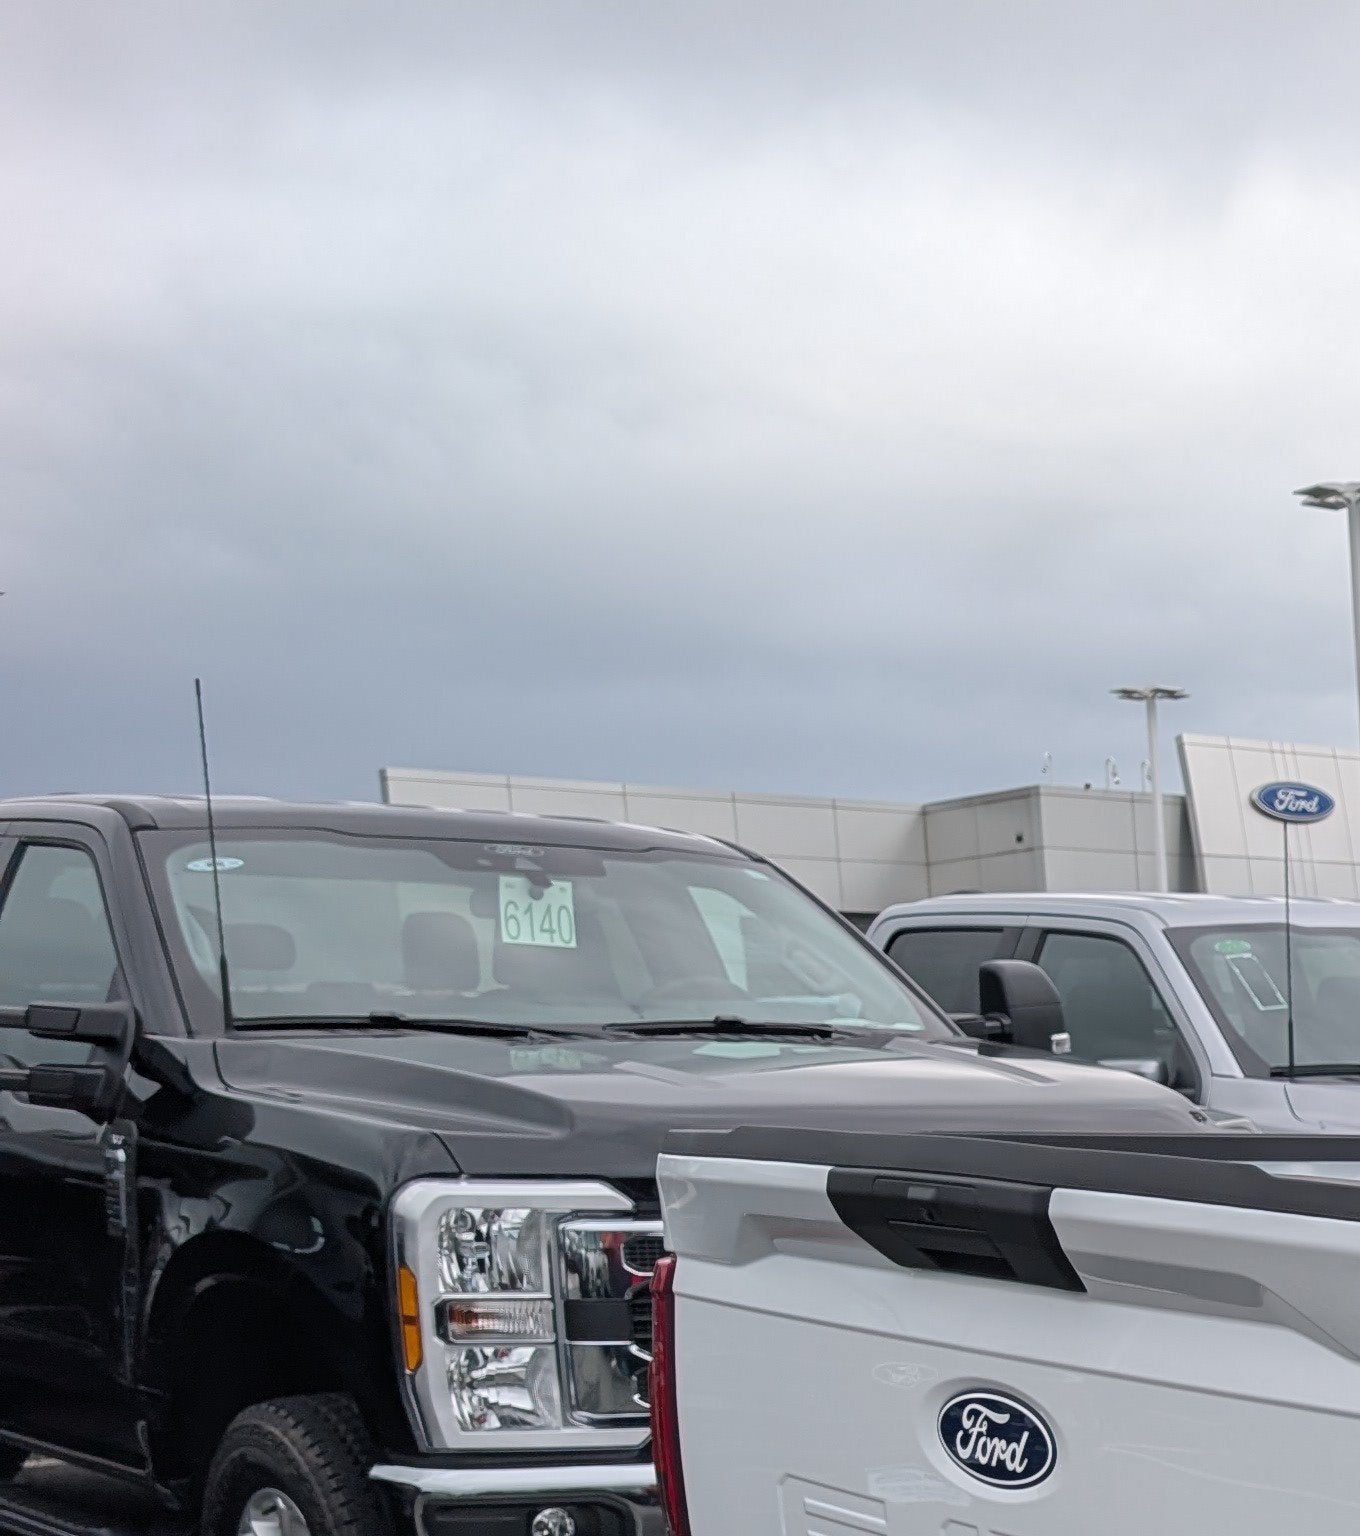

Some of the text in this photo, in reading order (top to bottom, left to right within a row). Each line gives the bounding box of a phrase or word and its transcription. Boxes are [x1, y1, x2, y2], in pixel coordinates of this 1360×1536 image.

[1274, 788, 1320, 813] Ford
[504, 900, 573, 944] 6140
[955, 1402, 1030, 1476] Ford
